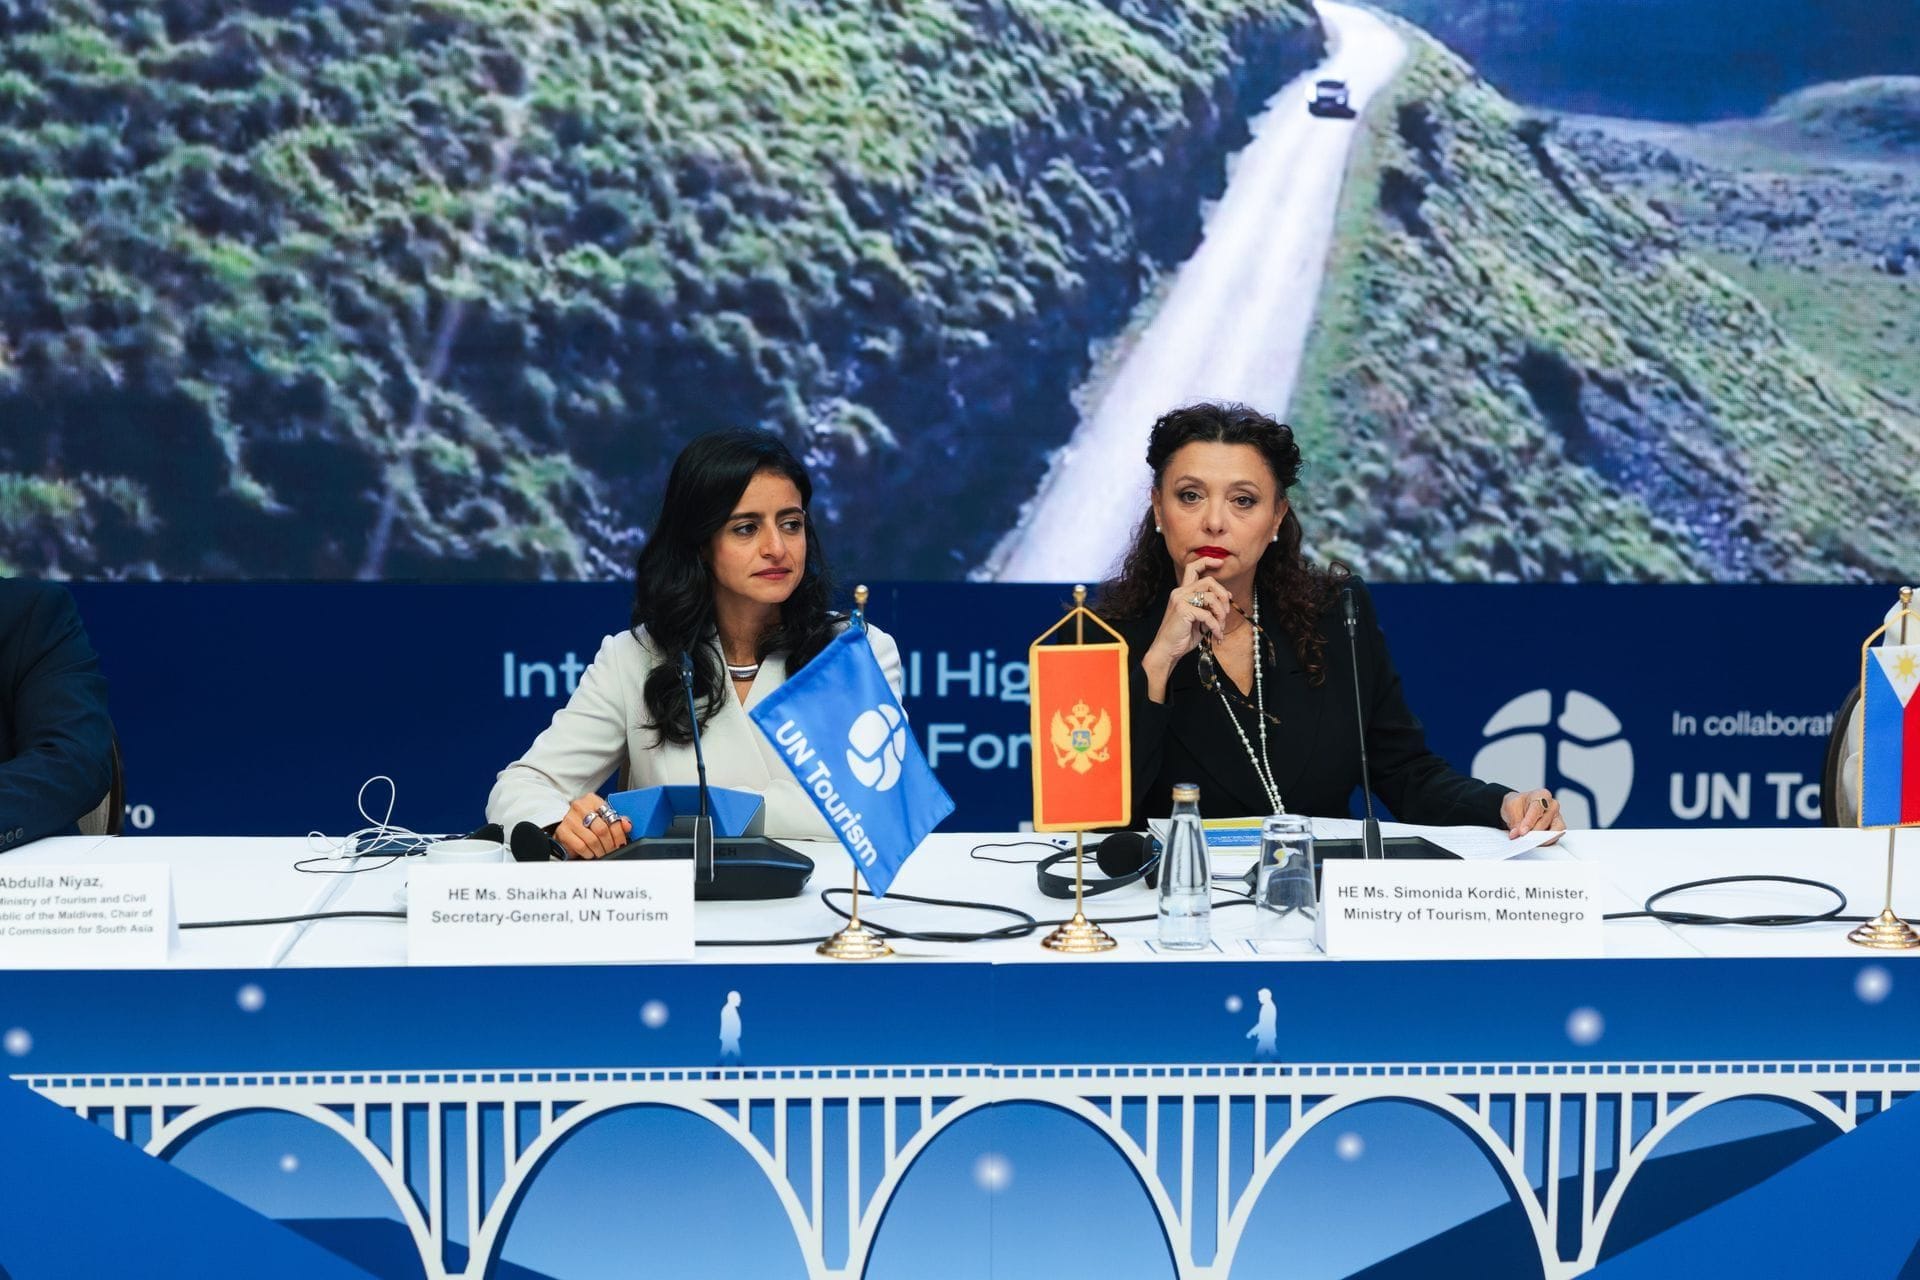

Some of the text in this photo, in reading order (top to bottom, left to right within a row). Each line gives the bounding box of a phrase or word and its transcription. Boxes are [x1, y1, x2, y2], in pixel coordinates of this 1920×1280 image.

[1672, 710, 1839, 737] In collaborat
[775, 719, 878, 868] UN Tourism
[1669, 771, 1823, 821] UN To
[0, 875, 104, 890] Abdulla Niyaz,
[41, 896, 51, 906] of
[54, 895, 97, 906] Tourism
[100, 894, 120, 904] and
[123, 893, 147, 903] Civil
[448, 886, 653, 902] HE Ms. Shaikha Al Nuwais,
[1338, 886, 1589, 902] HE Ms. Simonida Kordić, Minister,
[0, 909, 153, 921] blic of the Maldives, Chair of
[431, 909, 669, 926] Secretary-General, UN Tourism
[1344, 908, 1585, 924] Ministry of Tourism, Montenegro
[8, 926, 75, 937] Commission
[78, 925, 92, 935] for
[95, 924, 126, 934] South
[130, 924, 153, 933] Asia
